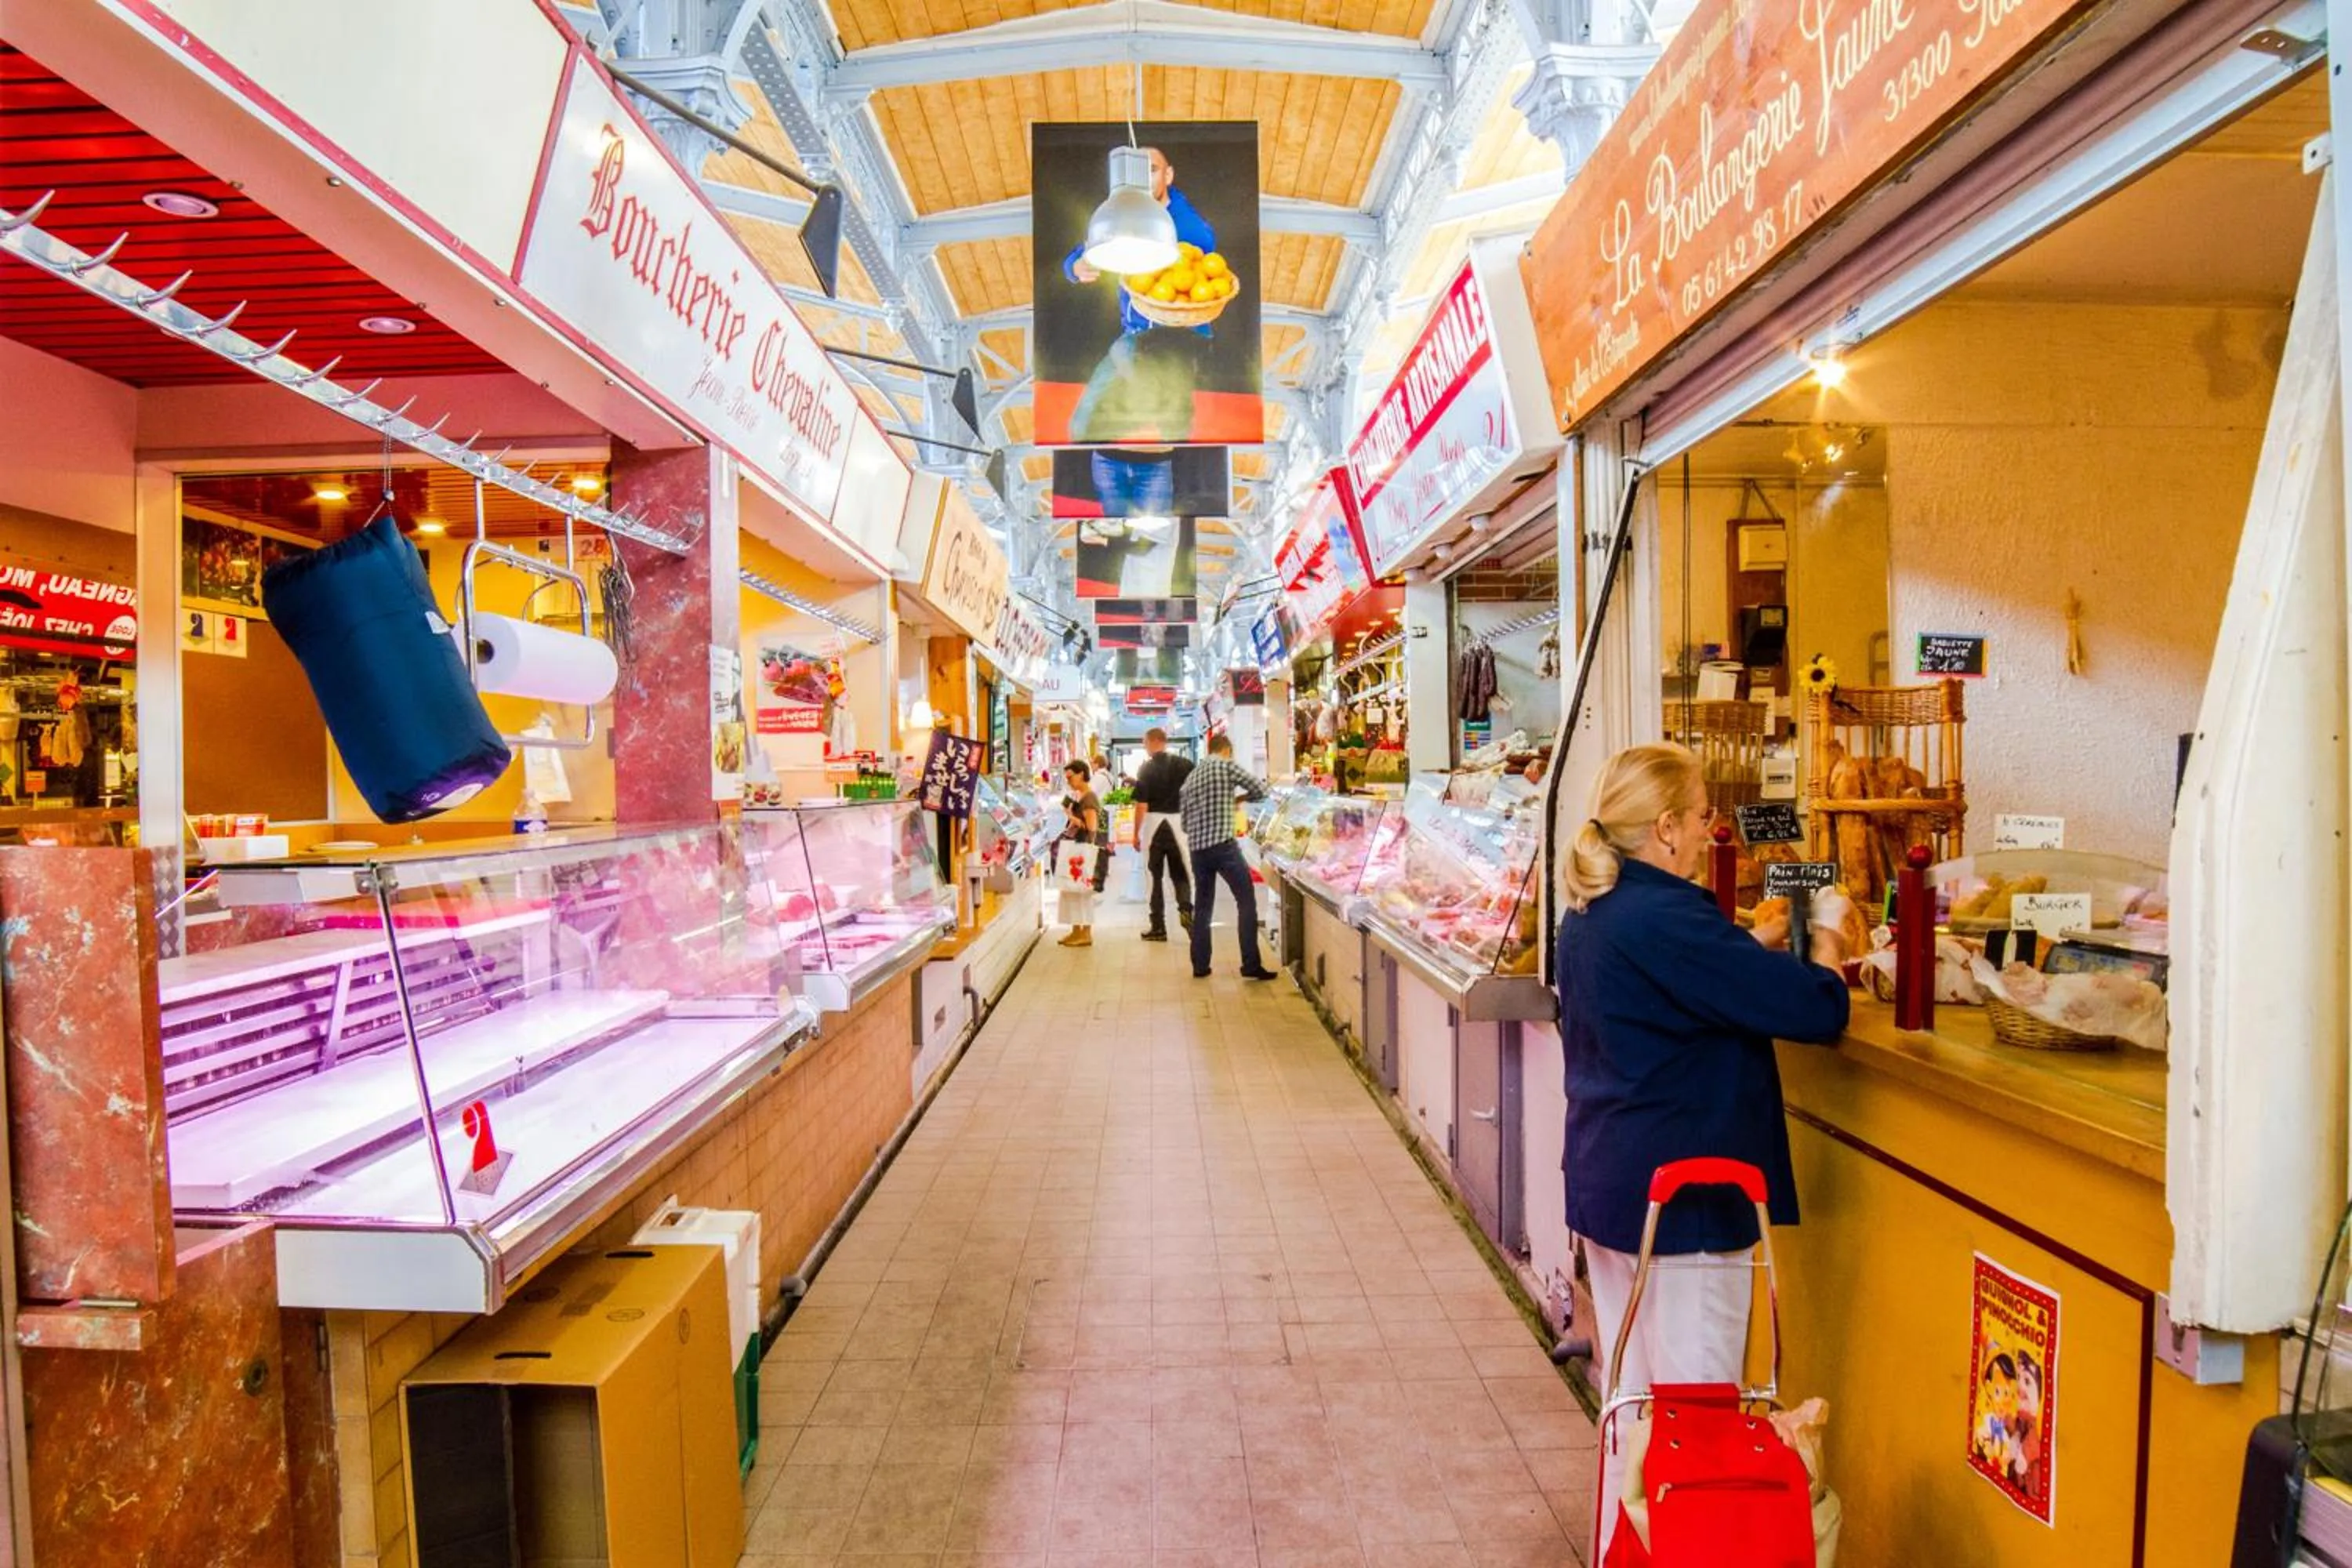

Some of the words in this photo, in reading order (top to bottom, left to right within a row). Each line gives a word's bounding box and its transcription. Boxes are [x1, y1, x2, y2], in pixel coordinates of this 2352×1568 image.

[1883, 30, 1951, 122] 31300
[579, 122, 746, 362] Boucherie
[750, 320, 843, 460] Chevaline
[1600, 199, 1645, 316] La
[1646, 139, 1806, 274] Boulangerie
[1682, 274, 1701, 317] 05
[1704, 252, 1722, 298] 61
[1726, 235, 1750, 278] 42
[1752, 208, 1777, 259] 98
[1782, 179, 1803, 234] 17
[1404, 274, 1489, 430] ARTISANALE
[1980, 1277, 2033, 1321] GUIGNOL
[1980, 1296, 2046, 1348] PINOCCHIO
